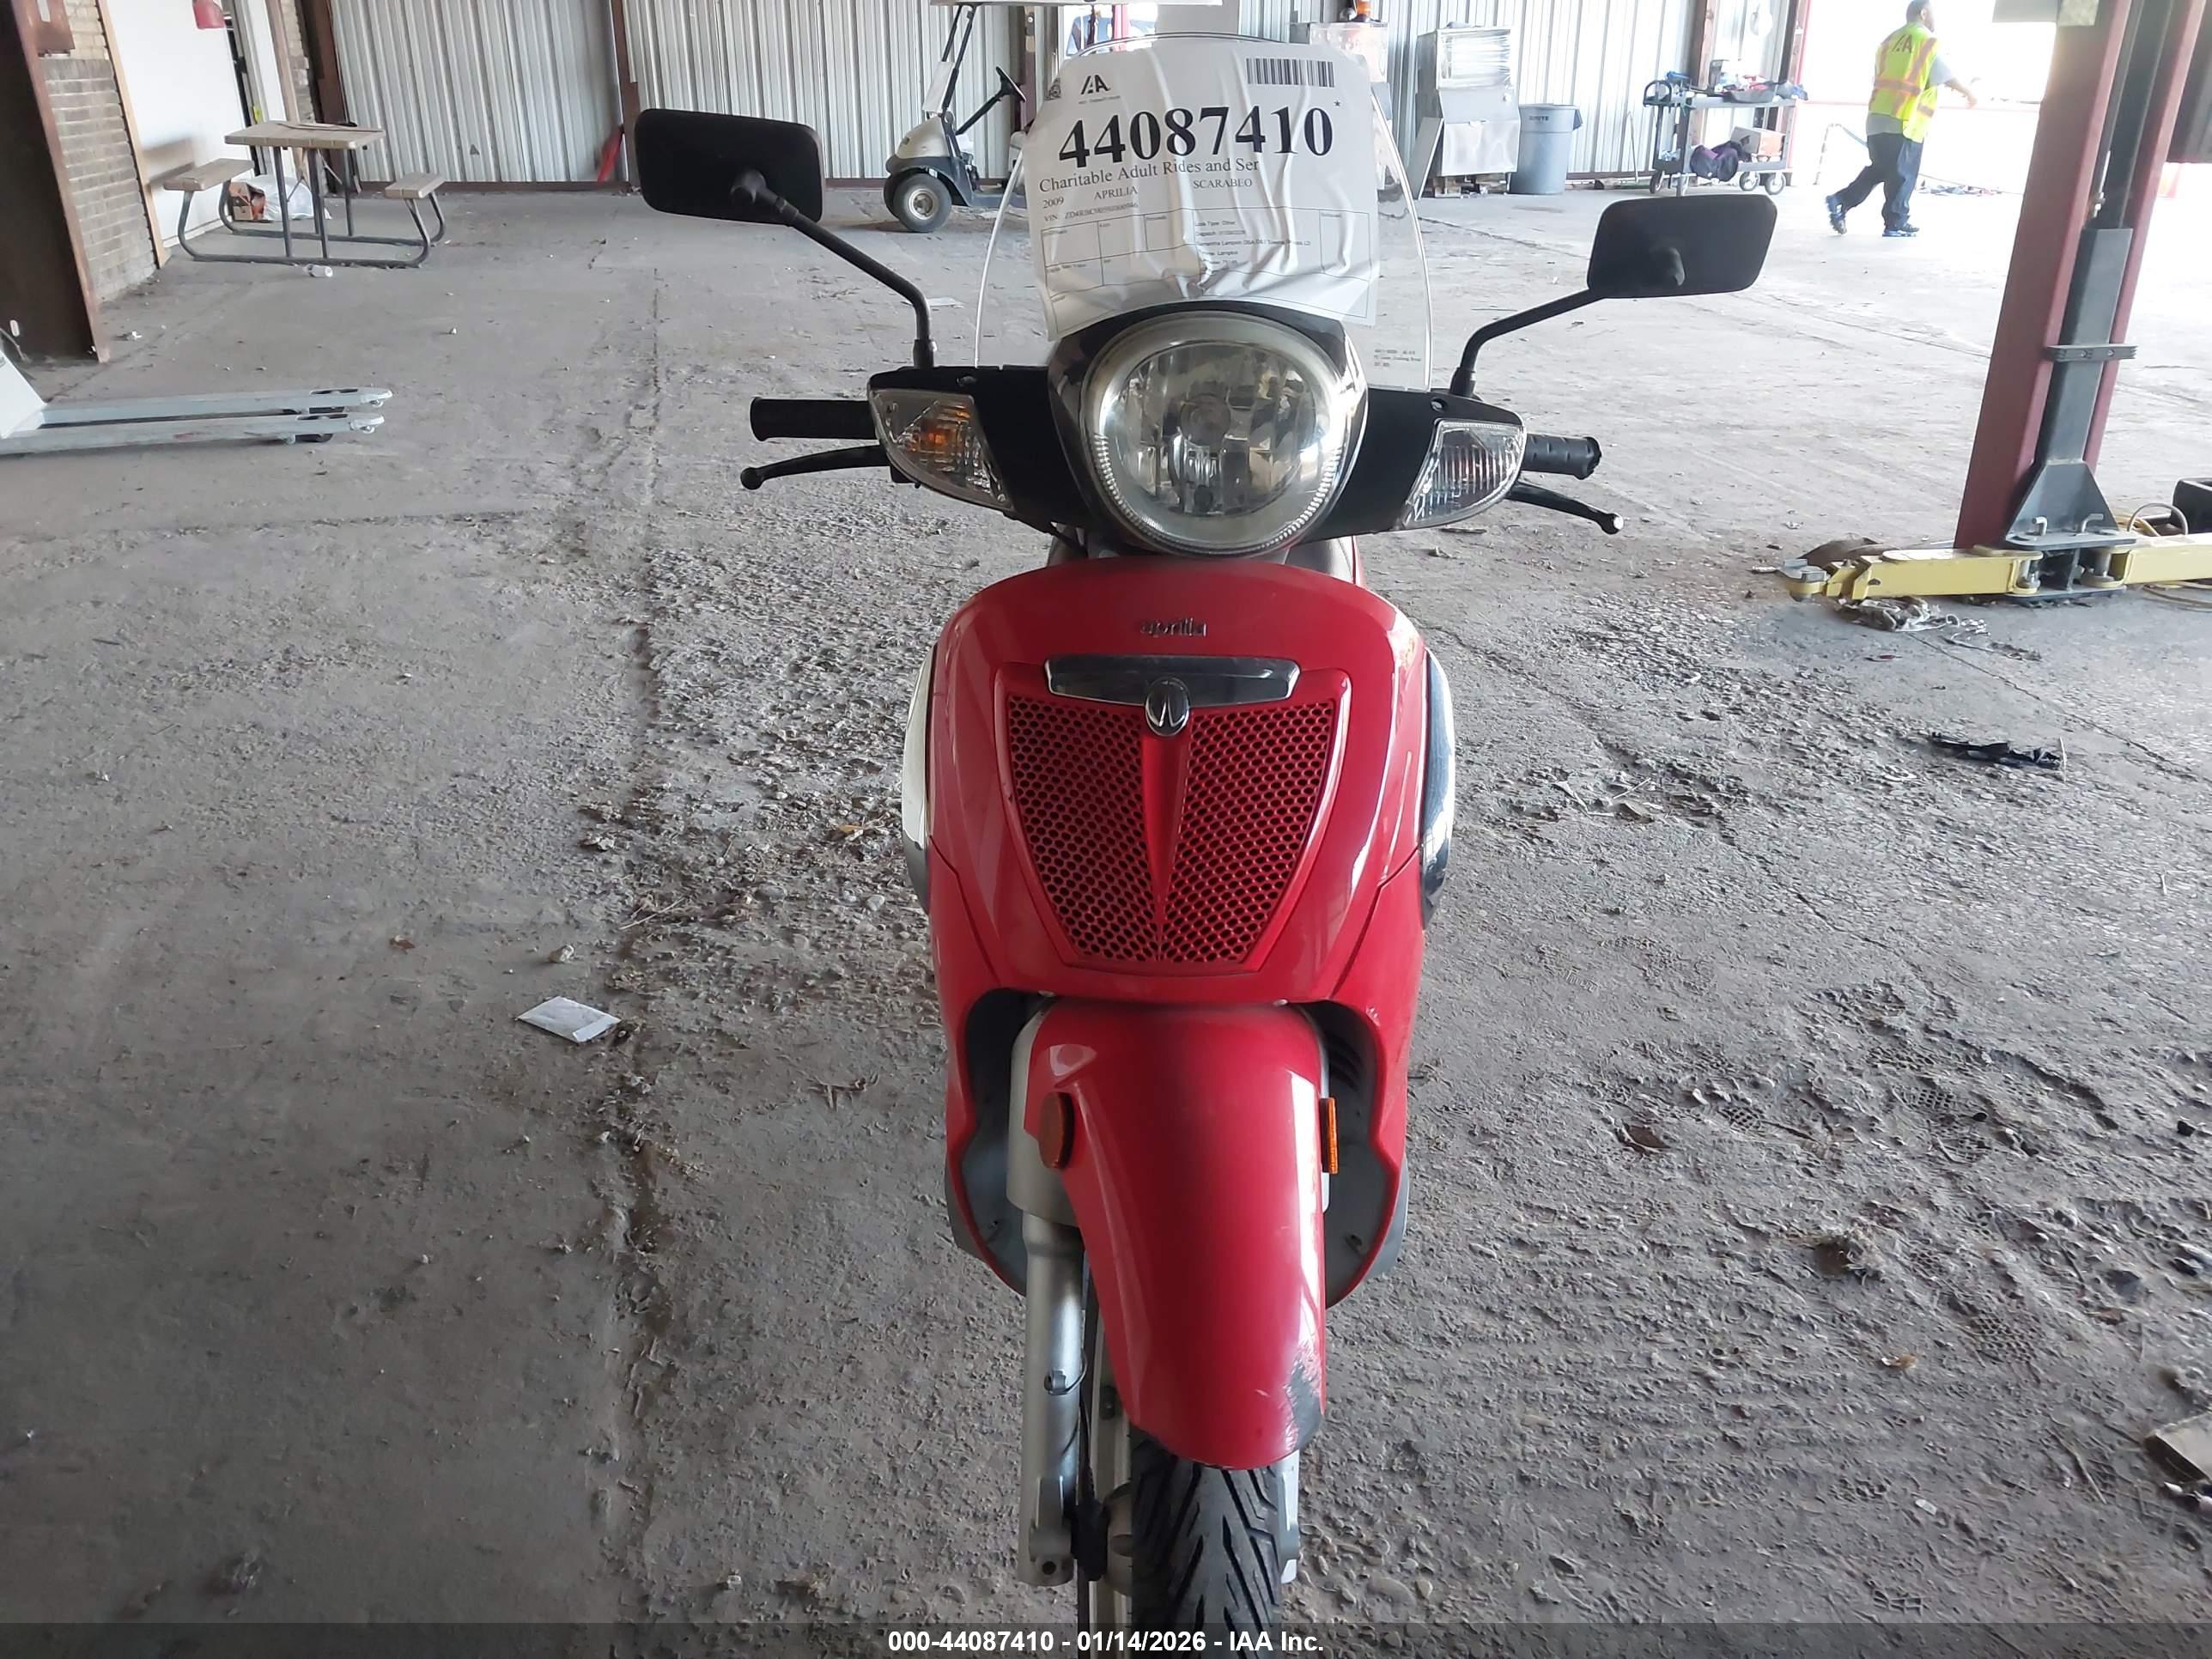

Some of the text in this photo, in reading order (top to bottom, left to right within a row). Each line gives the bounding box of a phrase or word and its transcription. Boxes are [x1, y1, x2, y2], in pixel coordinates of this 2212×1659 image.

[1059, 106, 1333, 168] 44087410
[1039, 158, 1259, 192] Charitable Adult Rides and Ser
[1042, 178, 1253, 209] 2009 APRILIA SCARABEO
